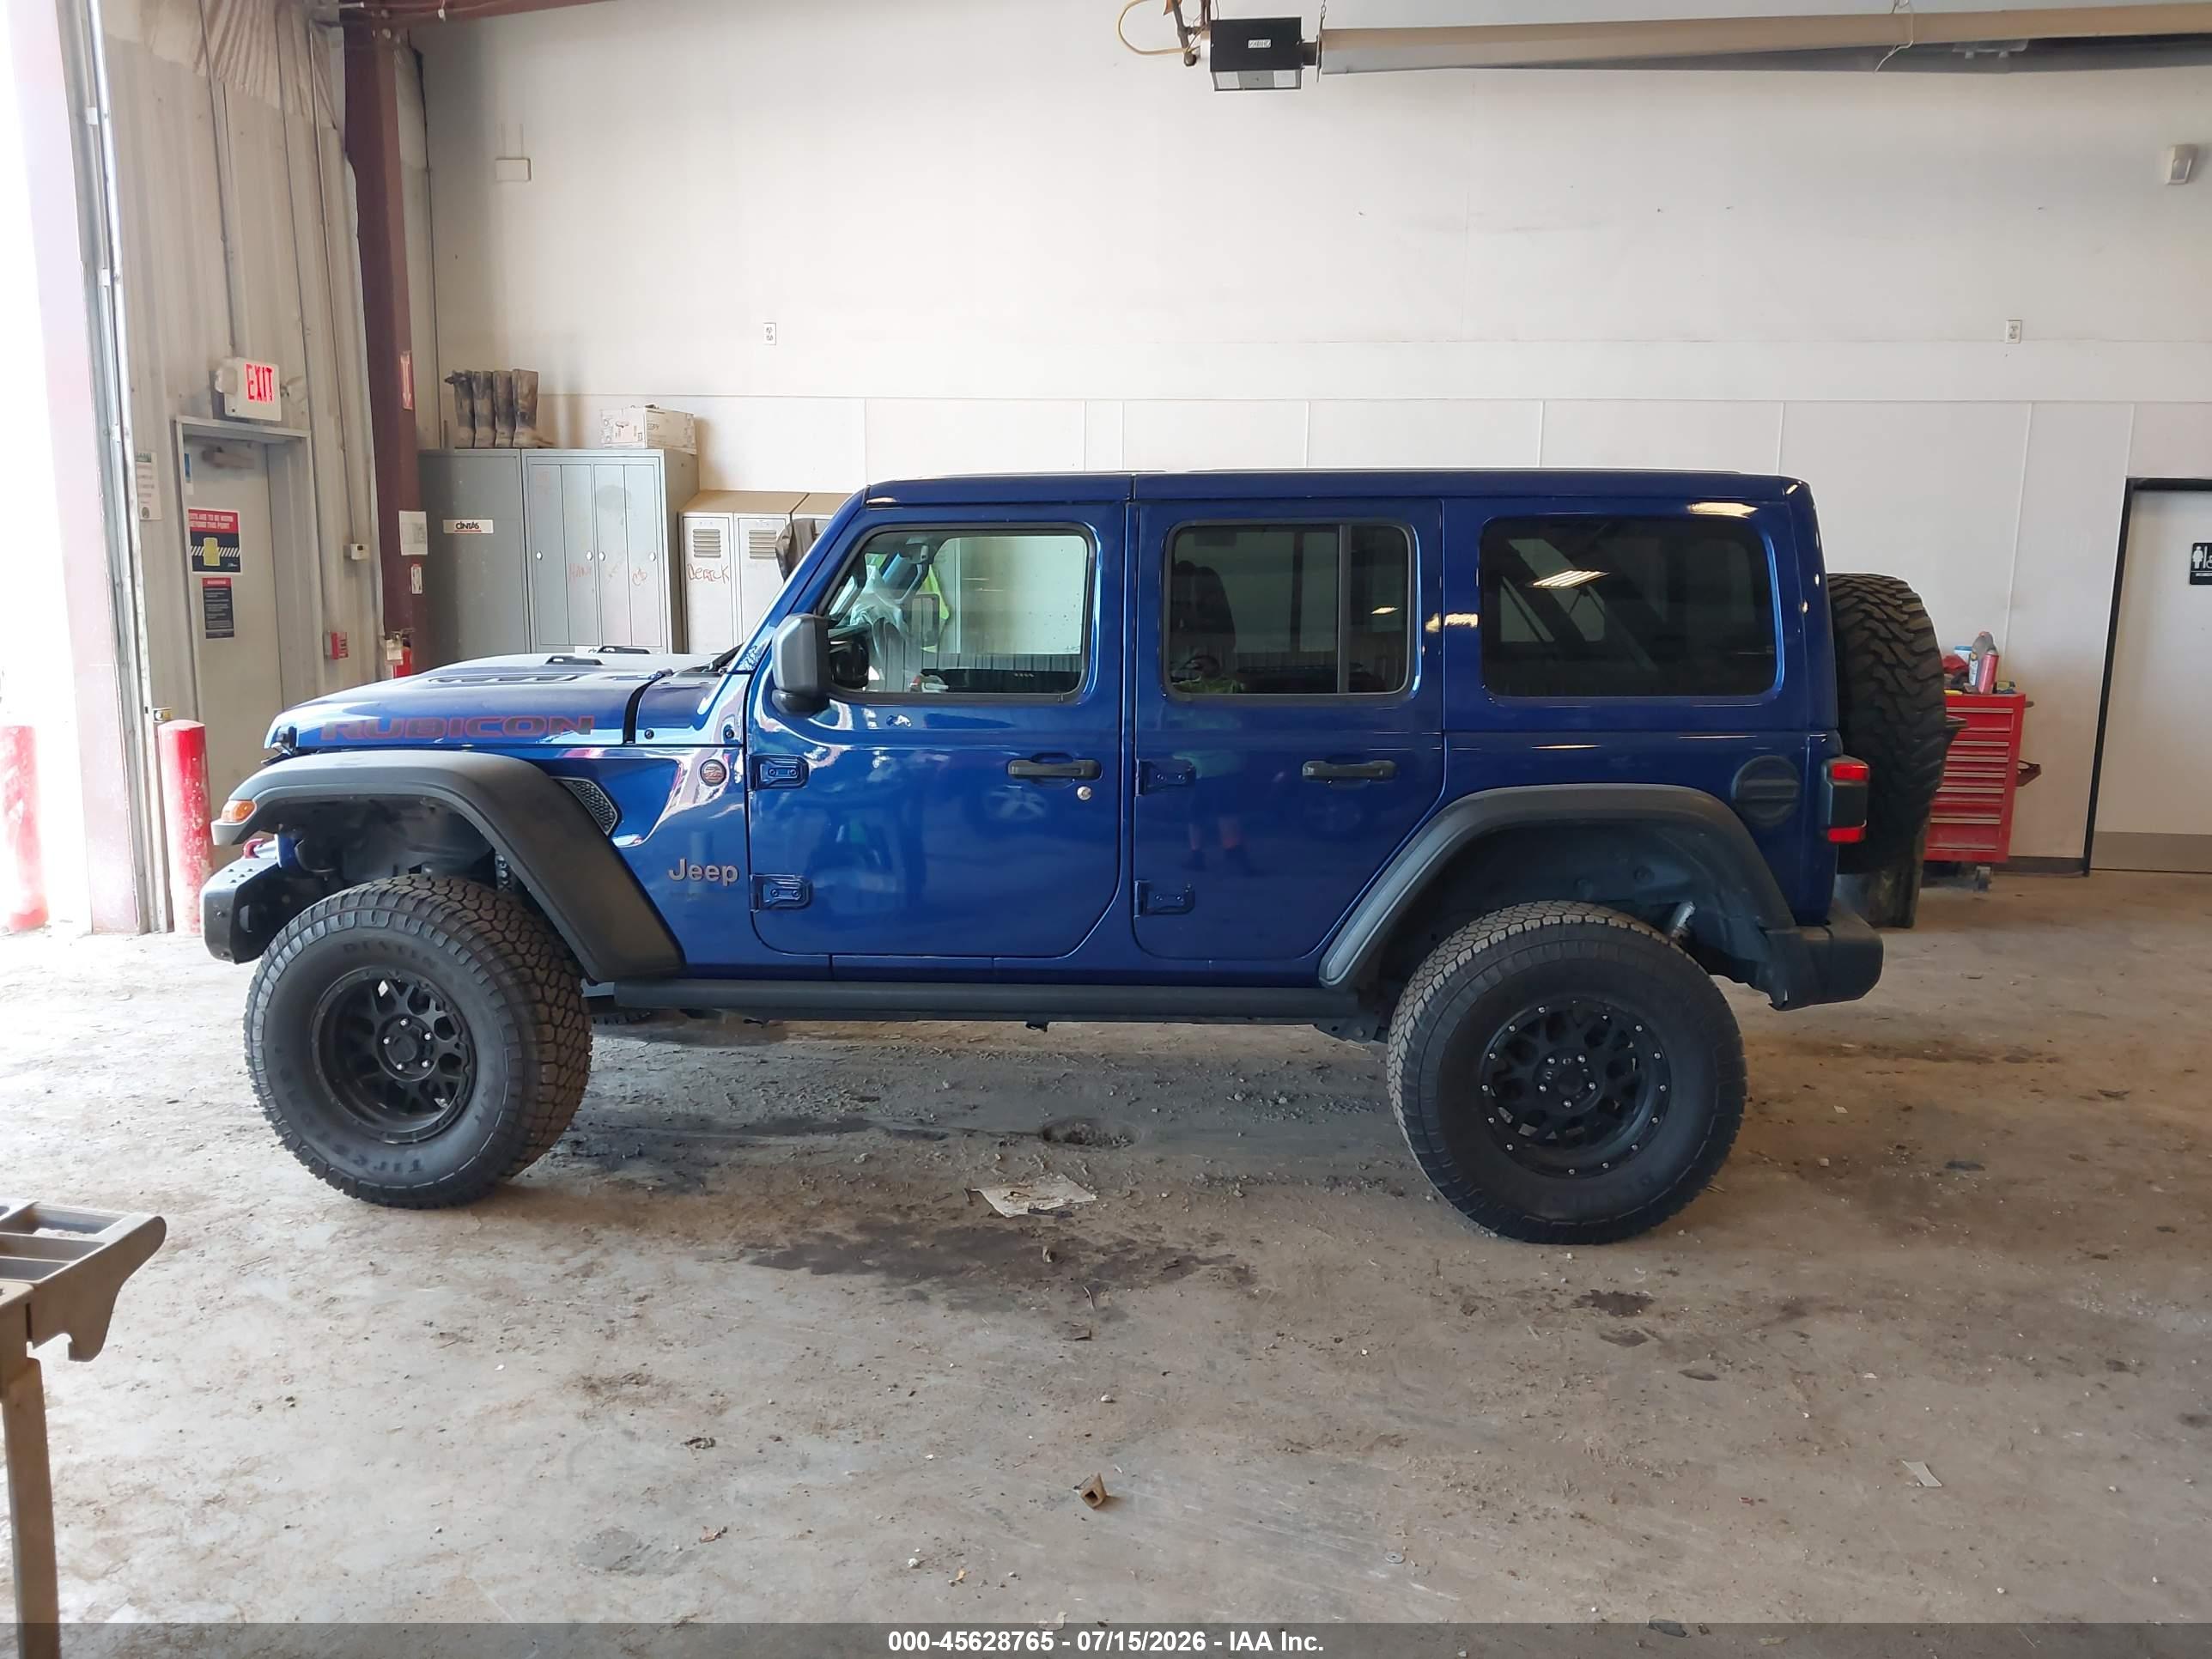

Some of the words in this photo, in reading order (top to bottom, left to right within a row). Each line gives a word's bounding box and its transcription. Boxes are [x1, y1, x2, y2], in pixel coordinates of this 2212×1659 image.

[246, 363, 273, 402] EXIT
[320, 715, 595, 741] RUBICON
[668, 858, 739, 887] Jeep
